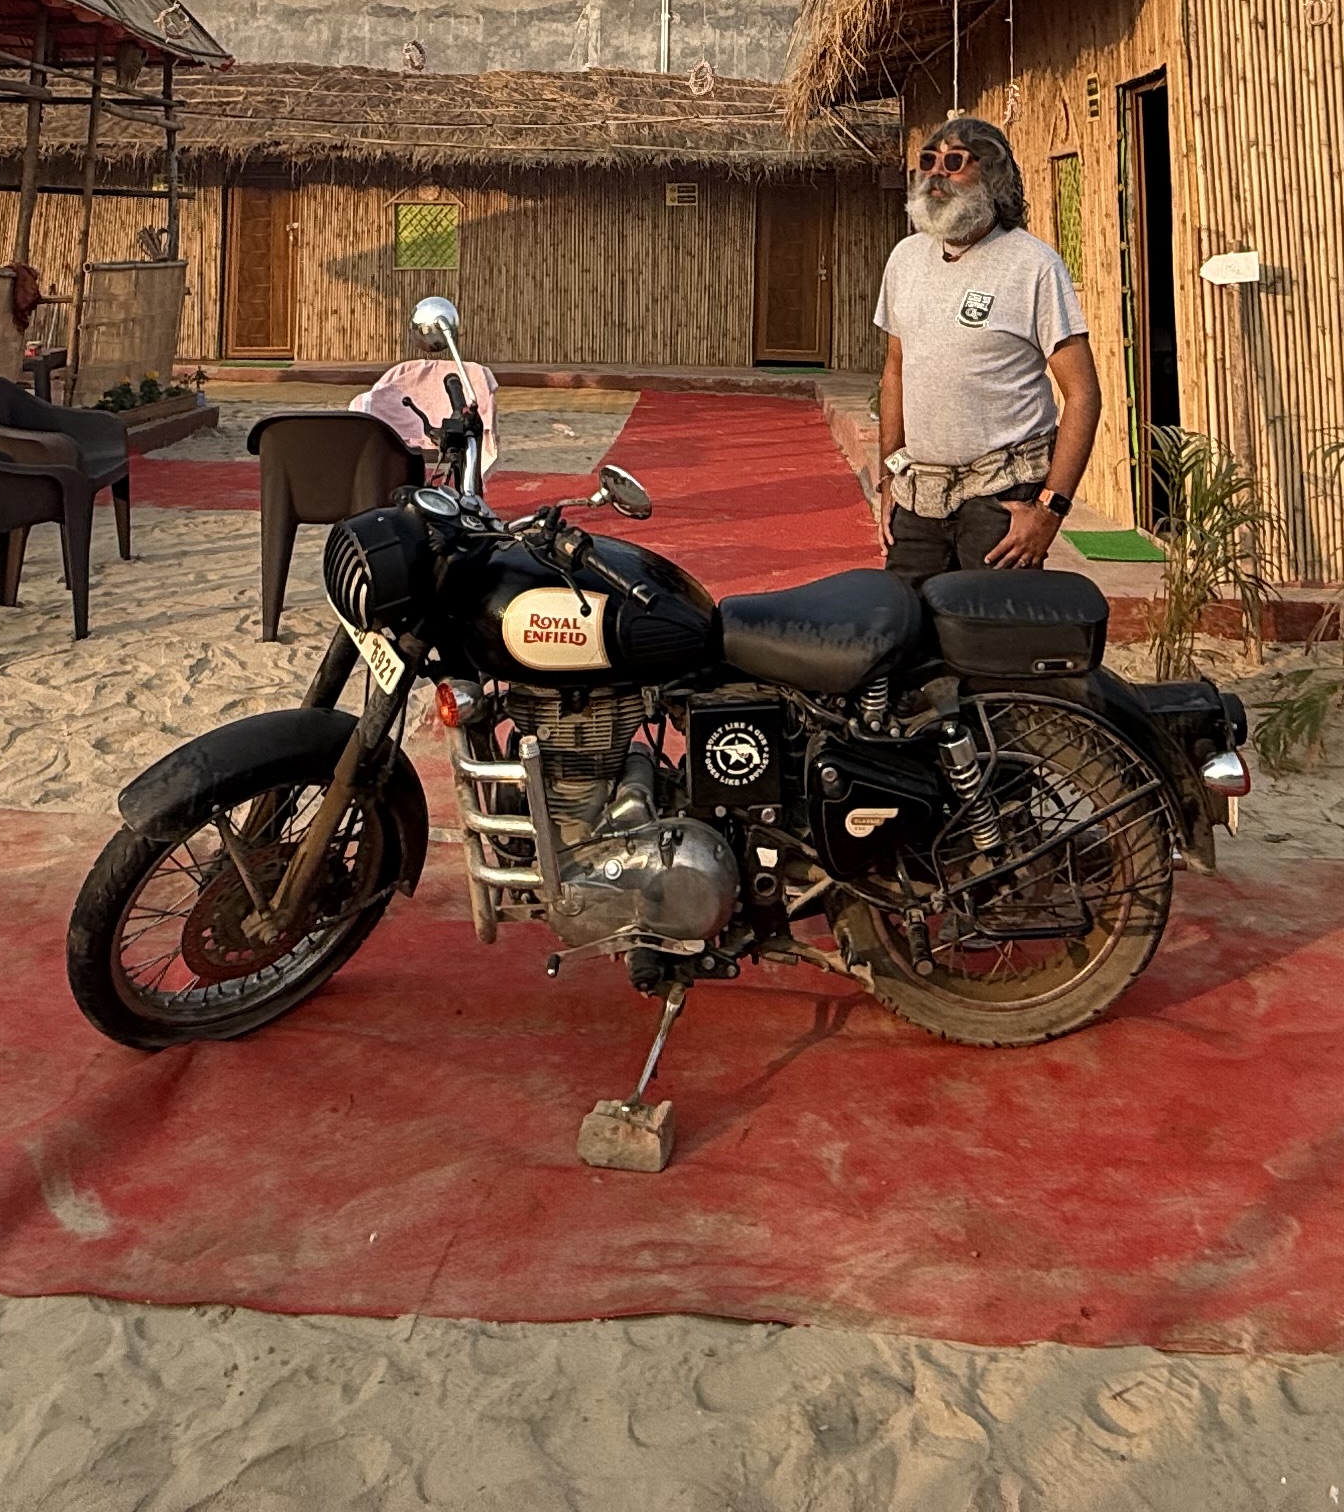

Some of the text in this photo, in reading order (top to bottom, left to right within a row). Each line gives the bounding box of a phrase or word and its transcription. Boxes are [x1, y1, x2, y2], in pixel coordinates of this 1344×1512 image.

[529, 613, 581, 630] ROYAL
[523, 629, 588, 646] ENFIELD
[370, 644, 398, 686] 6921
[705, 722, 768, 750] BUILT LIKE A GUN
[719, 775, 741, 786] LIKE
[748, 753, 769, 782] BULLET
